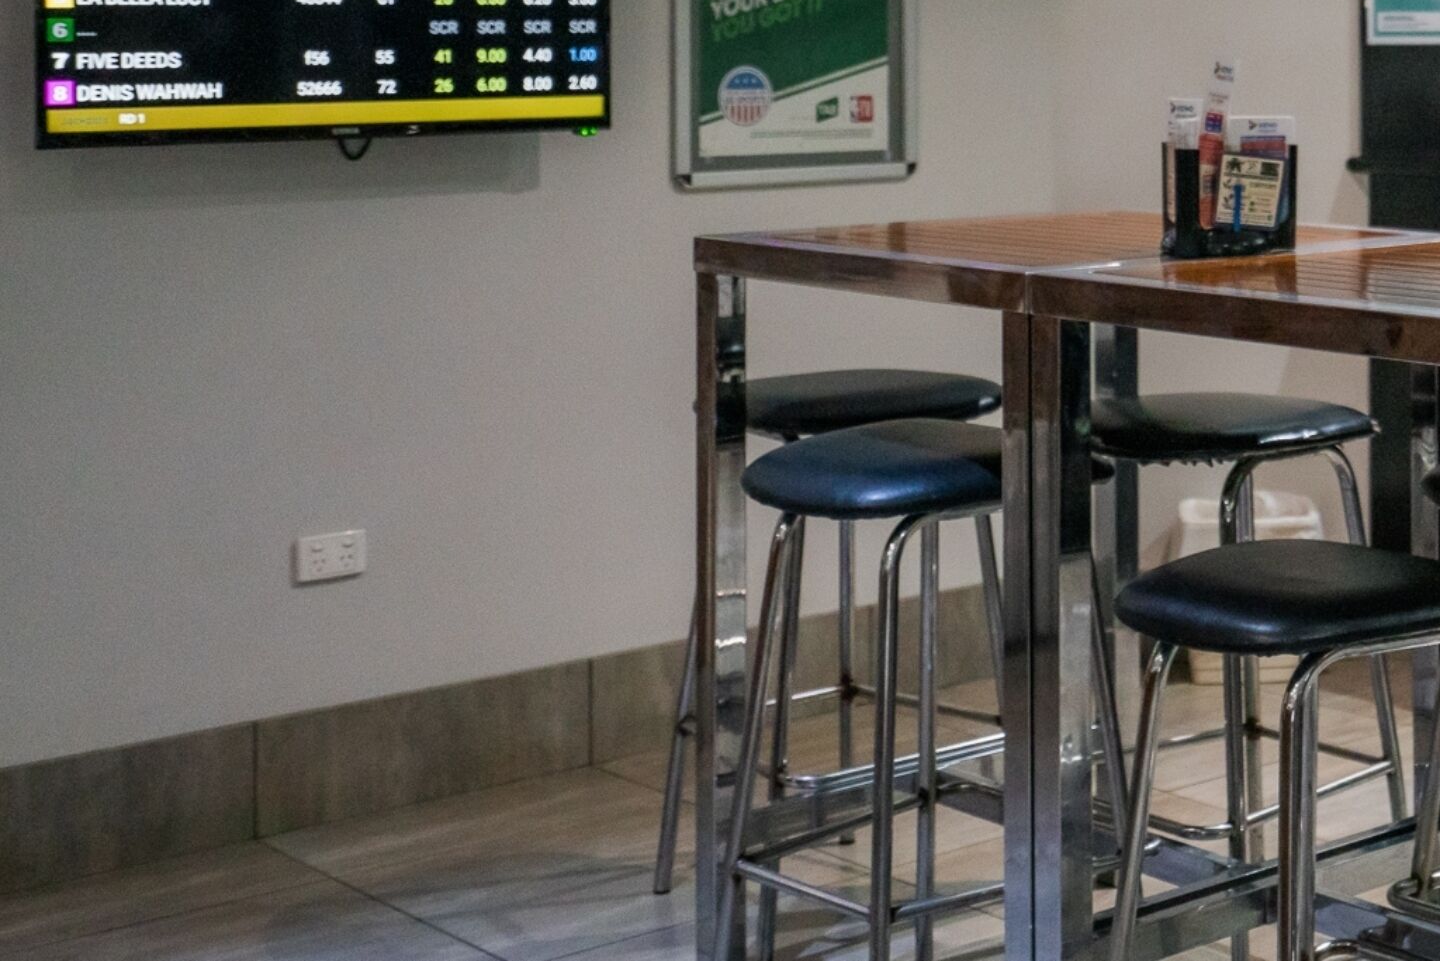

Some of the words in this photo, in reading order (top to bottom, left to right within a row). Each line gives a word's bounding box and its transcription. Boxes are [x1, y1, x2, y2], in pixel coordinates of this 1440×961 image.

[52, 22, 68, 38] 6
[429, 20, 460, 35] SCR
[477, 20, 506, 35] SCR
[523, 20, 552, 35] SCR
[568, 20, 598, 34] SCR
[51, 53, 69, 70] 7
[76, 53, 120, 70] FIVE
[121, 52, 182, 69] DEEDS
[52, 86, 68, 101] 8
[76, 85, 135, 102] DENIS
[136, 83, 223, 100] WAHWAH
